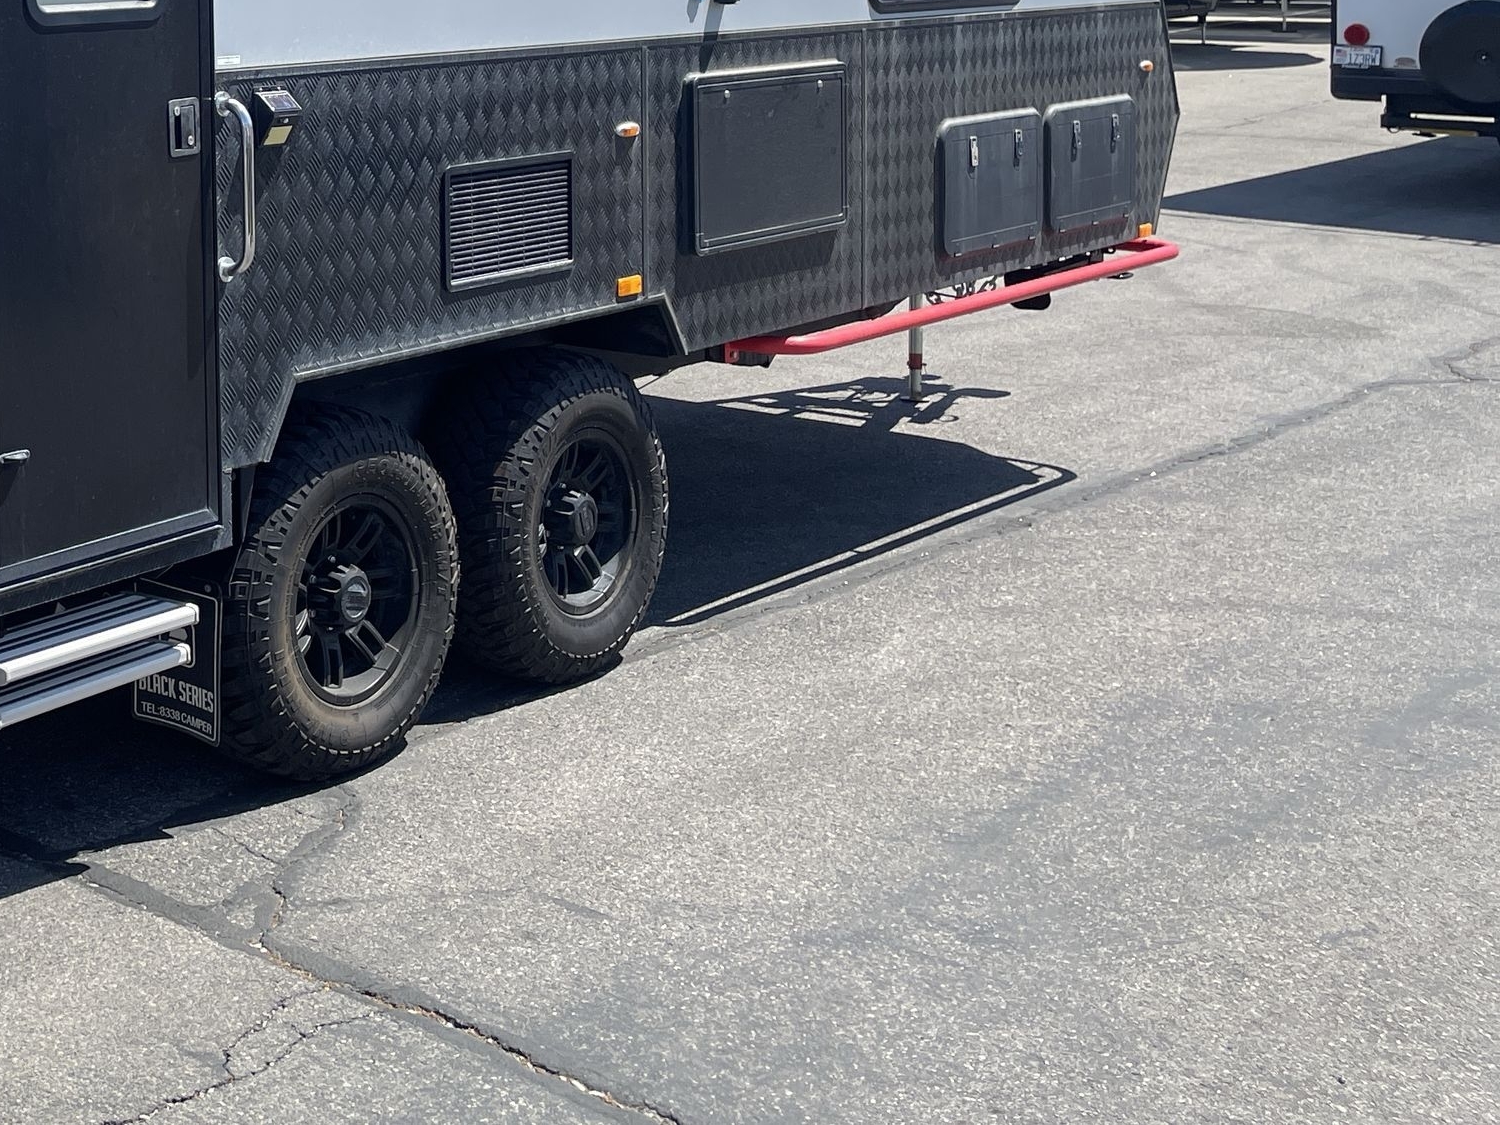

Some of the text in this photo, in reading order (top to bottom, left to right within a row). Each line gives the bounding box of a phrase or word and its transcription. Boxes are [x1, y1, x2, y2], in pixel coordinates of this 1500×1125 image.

[138, 674, 214, 713] BLACK SERIES
[181, 713, 212, 734] CAMPER
